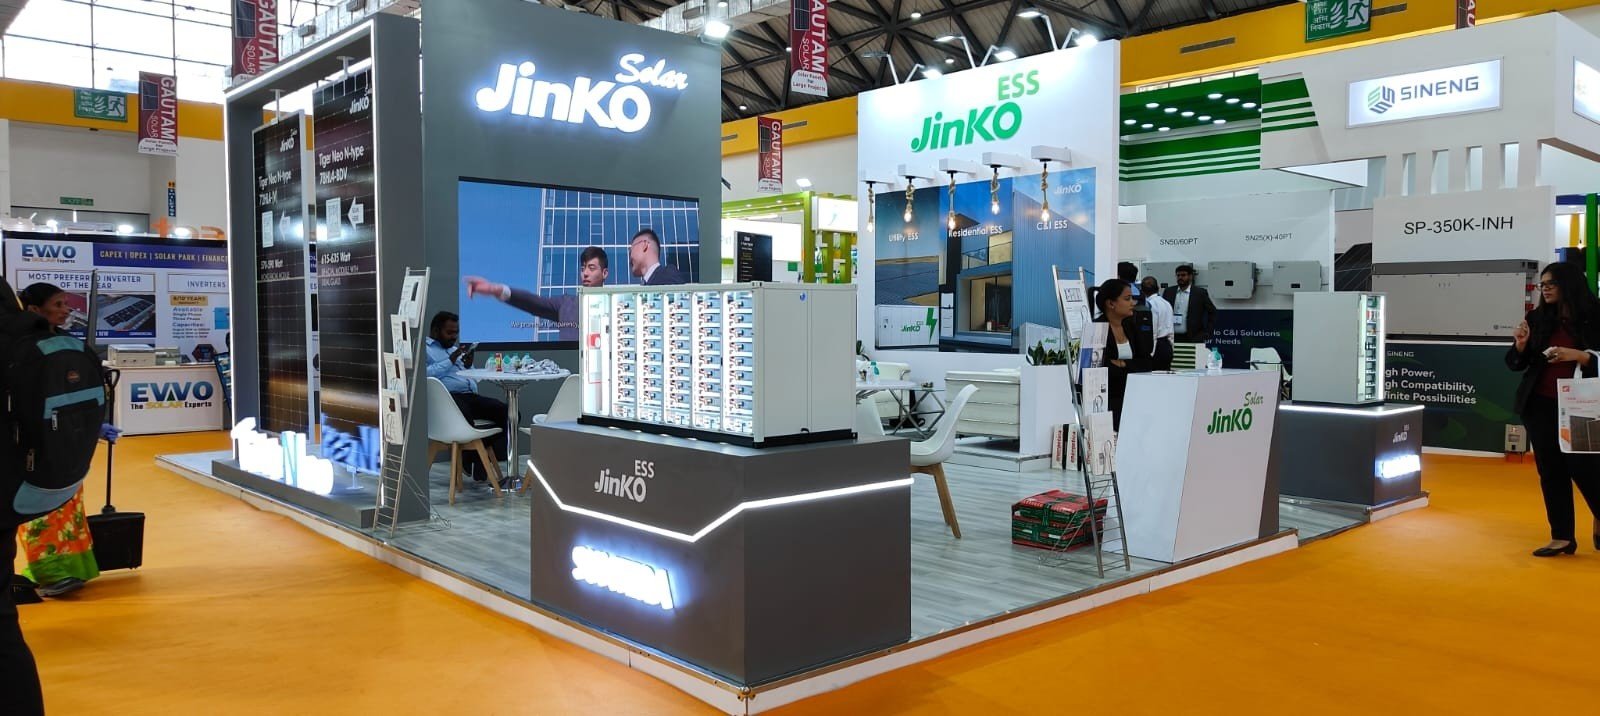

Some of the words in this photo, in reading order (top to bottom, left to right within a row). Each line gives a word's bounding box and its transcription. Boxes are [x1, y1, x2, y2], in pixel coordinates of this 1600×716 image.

[247, 45, 256, 74] SOLAR
[802, 38, 810, 71] SOLAR
[615, 53, 689, 90] Solar
[807, 84, 826, 92] Projects
[998, 70, 1040, 100] ESS
[1400, 76, 1479, 101] SINENG
[475, 61, 651, 133] JinKO
[161, 76, 176, 139] GAUTAM
[151, 115, 159, 138] SOLAR
[911, 101, 1022, 153] JinKO
[318, 152, 331, 168] Tiger
[331, 149, 343, 163] Neo
[344, 145, 364, 161] N-type
[771, 121, 781, 179] GAUTAM
[948, 227, 988, 238] Residential
[990, 225, 1003, 234] ESS
[1054, 220, 1068, 230] ESS
[1403, 216, 1514, 235] SP-350K-INH
[888, 233, 905, 242] Utility
[907, 231, 919, 241] ESS
[22, 243, 76, 259] EVVO
[99, 250, 122, 259] CAPEX
[129, 251, 148, 260] OPEX
[154, 251, 176, 260] SOLAR
[178, 253, 195, 261] PARK
[28, 273, 51, 281] MOST
[54, 273, 101, 282] PREFERRD
[103, 275, 141, 283] INVERTER
[60, 281, 70, 289] OF
[74, 281, 89, 289] THE
[187, 280, 226, 288] INVERTERS
[1240, 329, 1281, 337] Solutions
[1384, 368, 1398, 378] gh
[1401, 367, 1436, 379] Power,
[130, 381, 214, 403] EVVO
[1384, 379, 1398, 390] gh
[1400, 380, 1476, 393] Compatibility,
[184, 401, 212, 409] Experts
[1243, 391, 1264, 407] Solar
[1412, 392, 1477, 404] Possibilities
[1207, 407, 1253, 435] JinKO
[634, 459, 655, 479] ESS
[594, 468, 647, 503] JinKO
